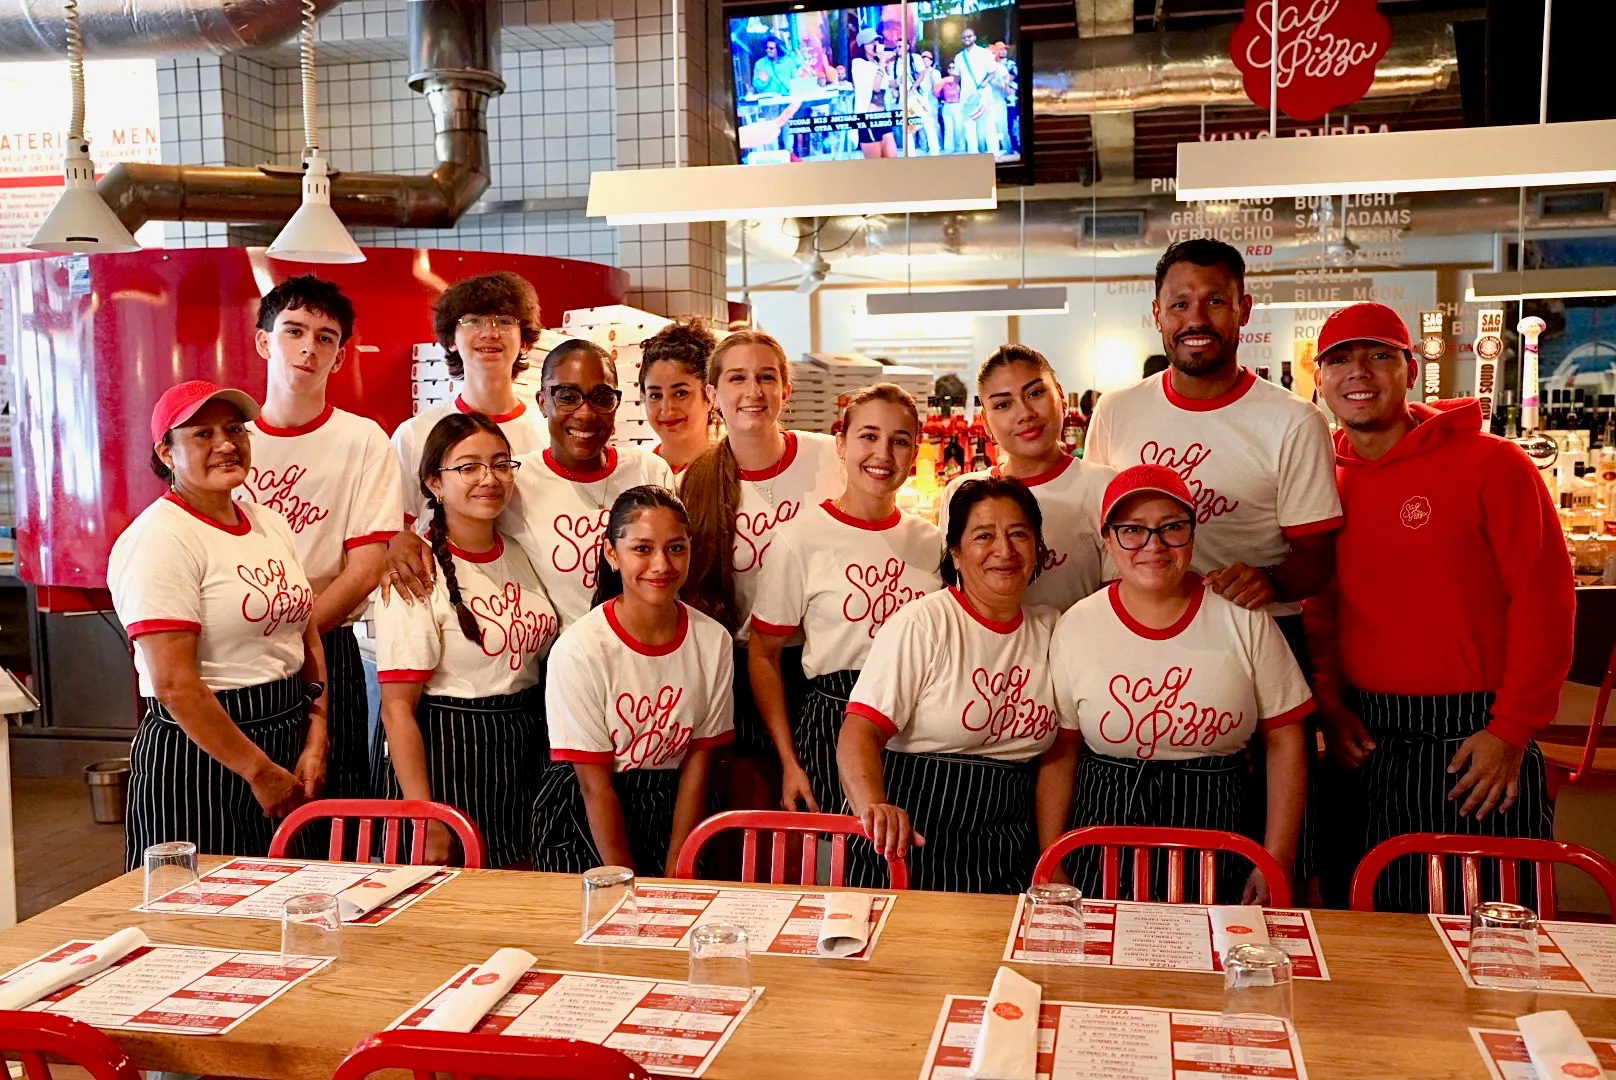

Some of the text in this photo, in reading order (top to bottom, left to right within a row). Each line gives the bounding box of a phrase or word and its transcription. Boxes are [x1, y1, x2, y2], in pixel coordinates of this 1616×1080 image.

[1246, 0, 1339, 68] Sag
[1277, 30, 1377, 88] Pizza
[1171, 208, 1274, 226] GRECHETTO
[1294, 209, 1412, 228] SA ADAMS
[1345, 192, 1397, 208] LIGHT
[1166, 226, 1274, 243] VERDICCHIO
[1246, 245, 1273, 256] RED
[1294, 268, 1362, 284] STELLA
[1294, 285, 1406, 302] BLUE MOON
[1423, 313, 1443, 326] SAG
[1482, 314, 1501, 326] SAG
[1425, 362, 1440, 394] SQUID
[1479, 364, 1494, 394] SQUID
[236, 558, 288, 623] Sag
[263, 584, 312, 636] Pizz
[843, 557, 906, 622] Sag
[470, 581, 522, 656] Sag
[610, 685, 683, 757] Sag
[962, 665, 1031, 732] Sag
[980, 695, 1058, 746] Pizza
[1100, 666, 1193, 744] Sag
[622, 720, 694, 772] Pizz
[1136, 700, 1244, 760] Pizza
